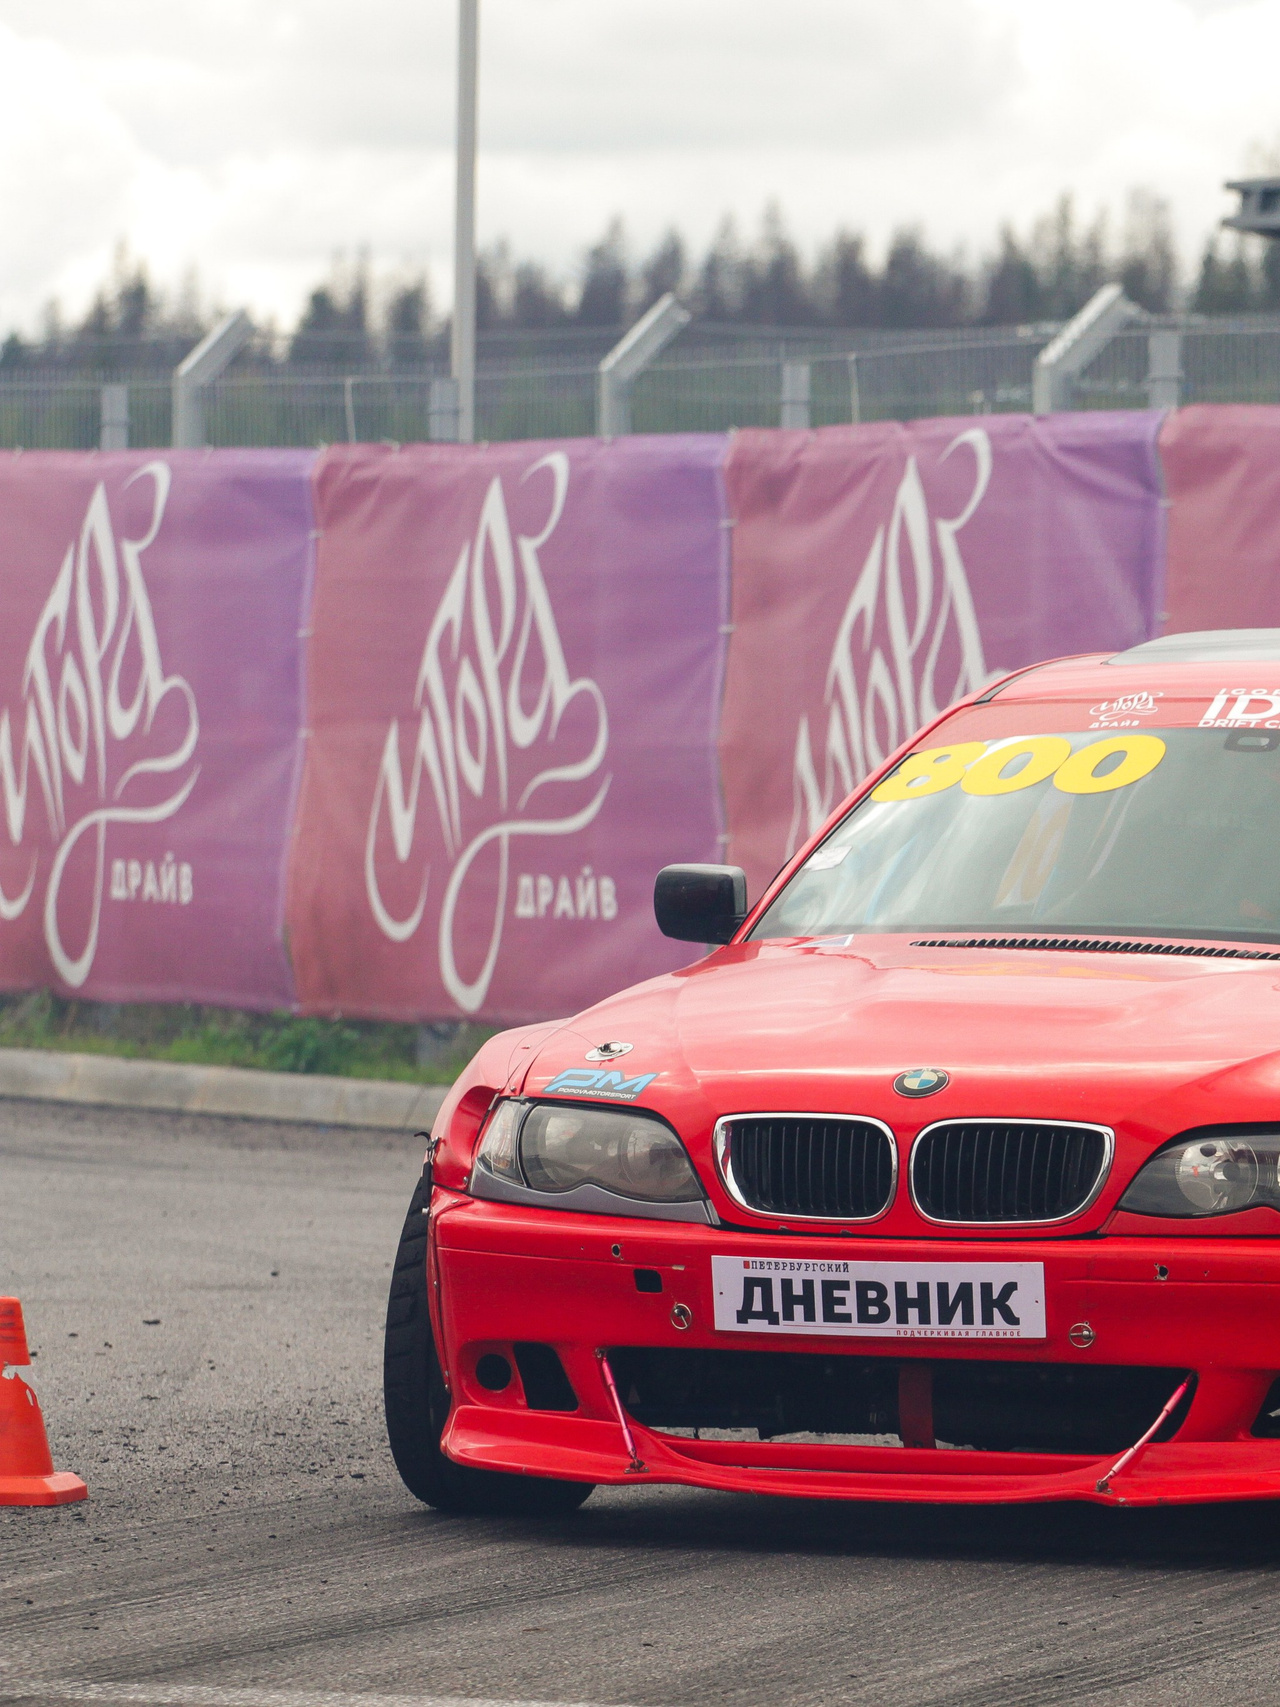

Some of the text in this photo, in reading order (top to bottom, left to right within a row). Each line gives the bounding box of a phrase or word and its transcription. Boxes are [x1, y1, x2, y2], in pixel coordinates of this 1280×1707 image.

[1088, 719, 1140, 729] ДРАЙВ
[1197, 718, 1261, 728] DRIFT
[870, 734, 1166, 802] 800
[111, 850, 193, 905] ДРАЙВ
[515, 864, 618, 921] ДРАЙВ
[543, 1068, 658, 1093] PM
[557, 1087, 637, 1100] POPOVMOTORSPORT
[750, 1260, 850, 1273] ПЕТЕРБУРГСКИЙ
[736, 1276, 1020, 1326] ДНЕВНИК
[896, 1329, 970, 1338] ПОДЧЕРКИВАЯ
